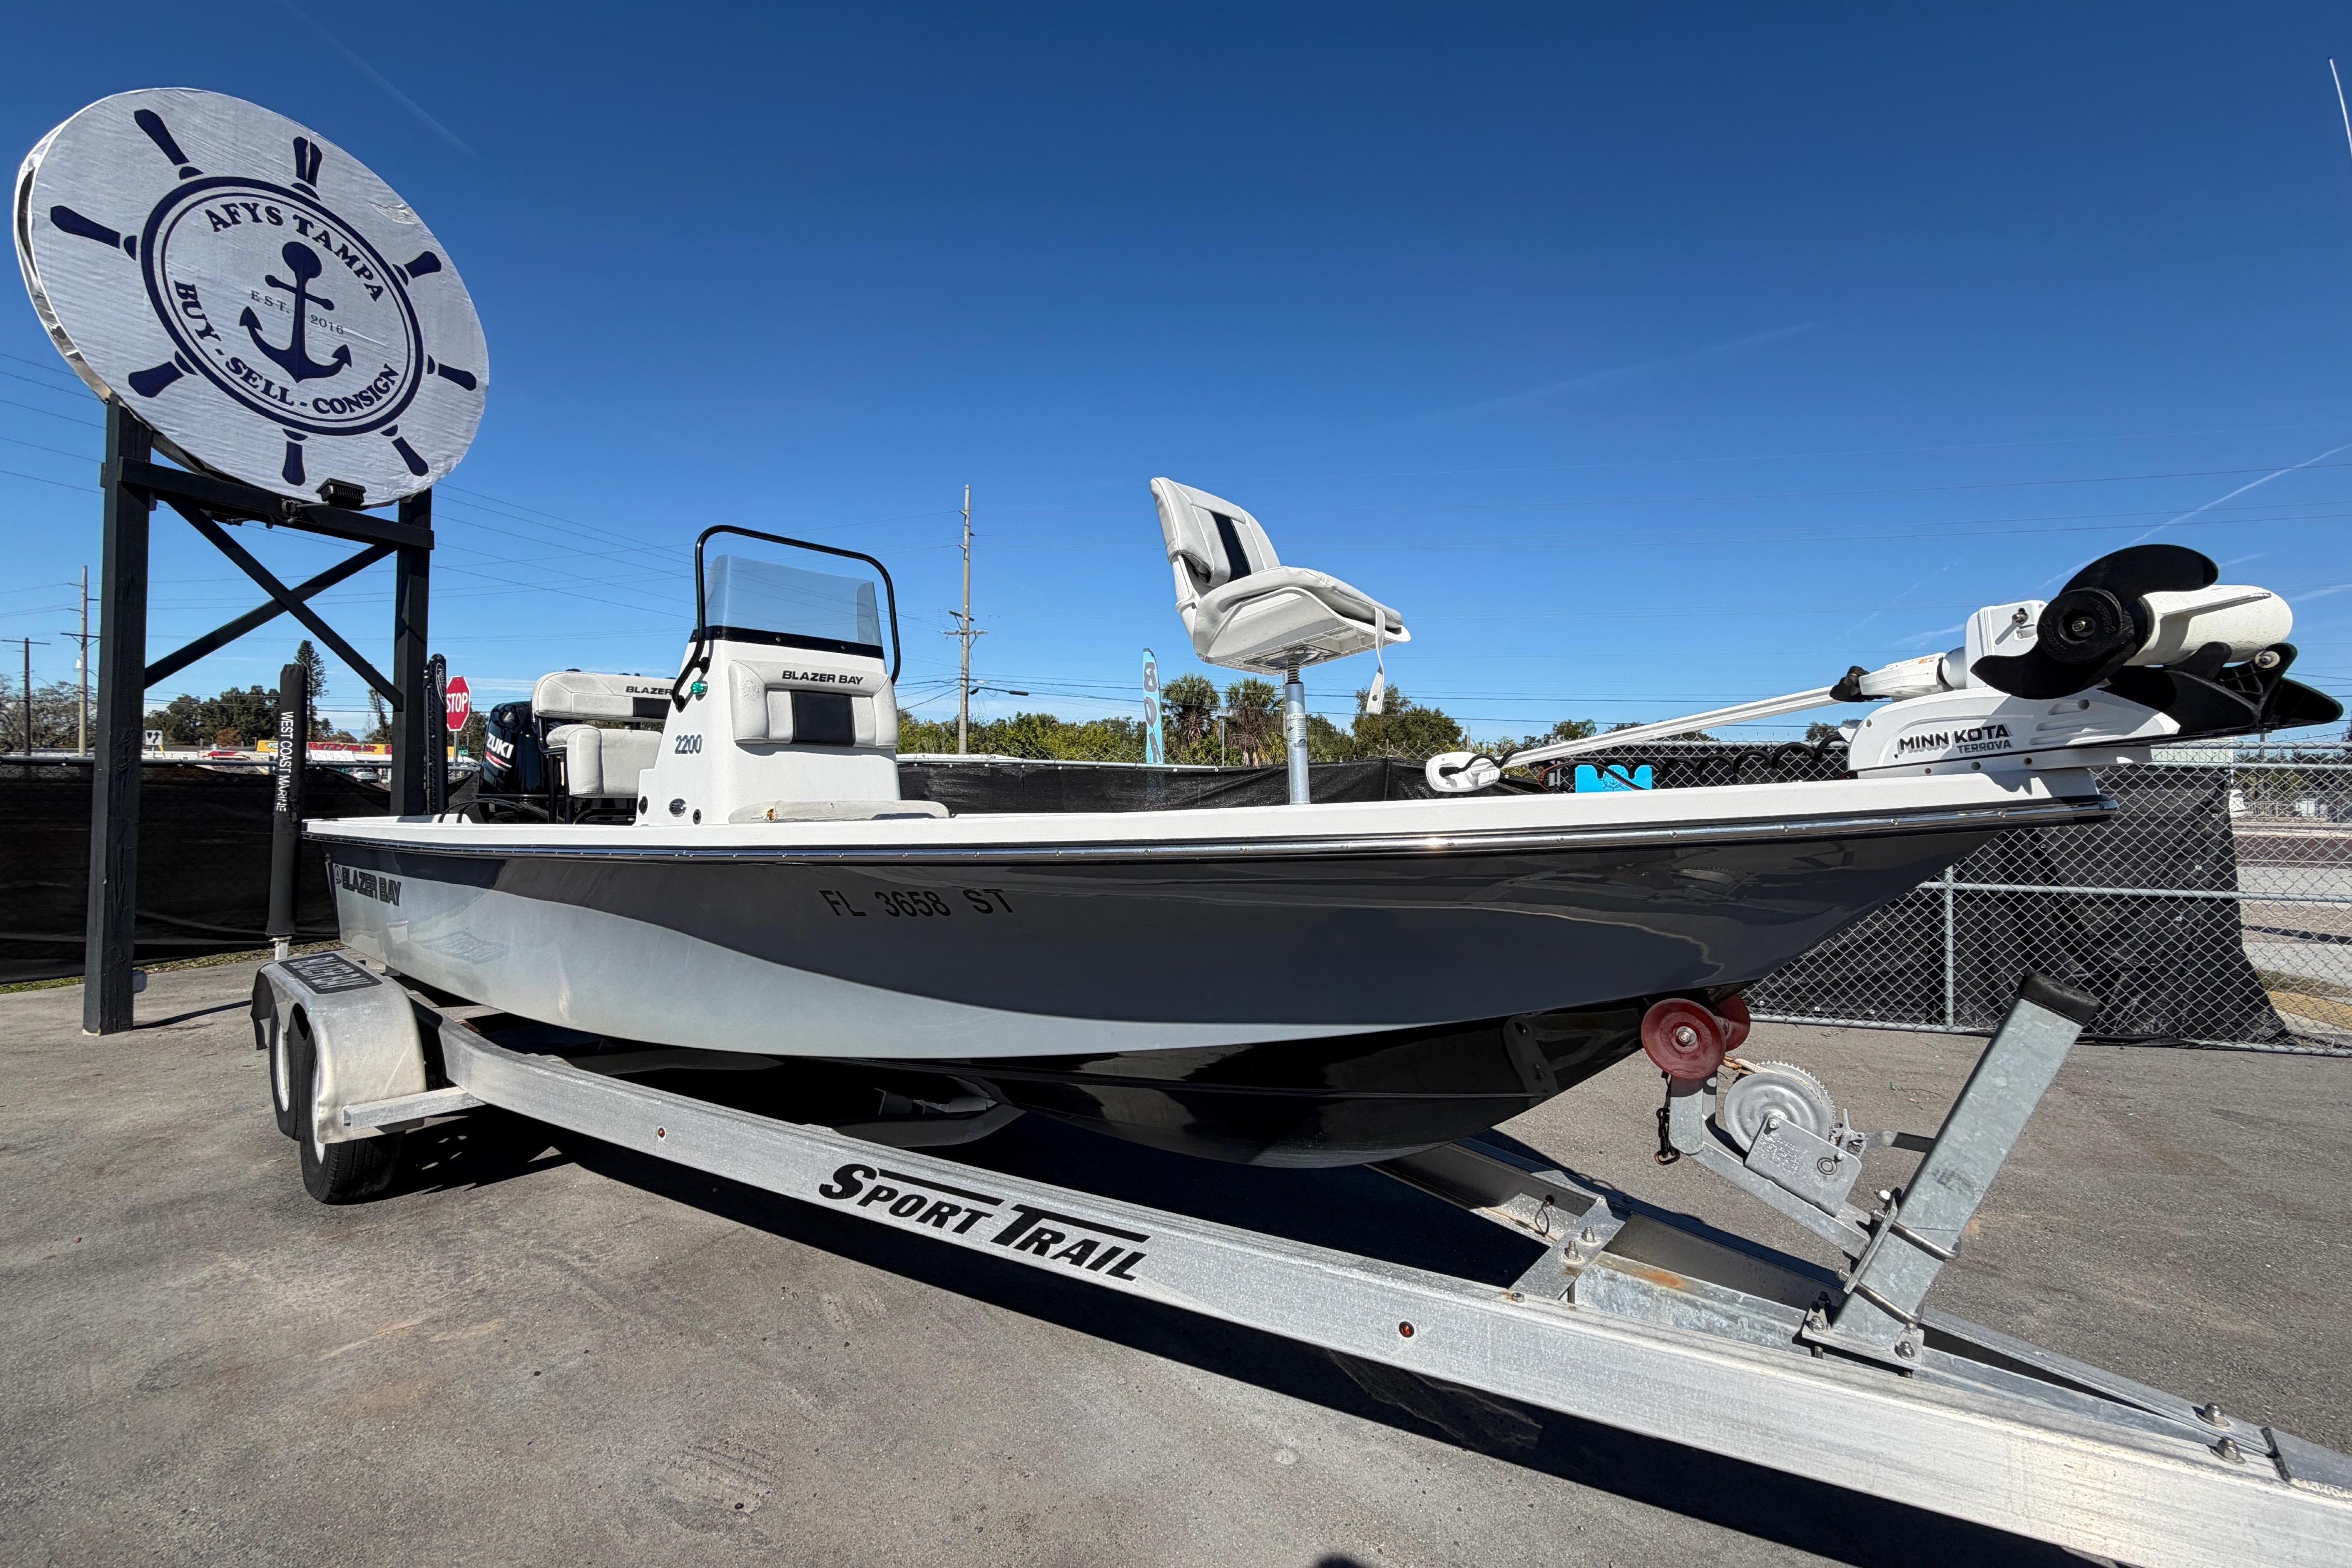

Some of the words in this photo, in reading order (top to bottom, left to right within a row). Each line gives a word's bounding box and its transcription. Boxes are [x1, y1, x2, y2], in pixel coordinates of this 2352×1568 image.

[205, 202, 283, 232] AFYS
[293, 214, 383, 302] TAMPA
[250, 290, 290, 313] EST.
[310, 314, 344, 335] 2016
[174, 280, 222, 342] BUY
[225, 357, 294, 406] SELL
[312, 363, 399, 414] CONSIGN
[625, 686, 673, 696] BLAZER
[782, 670, 836, 683] BLAZER
[838, 674, 864, 685] BAY
[446, 692, 468, 713] STOP
[280, 712, 294, 739] WEST
[1899, 732, 1950, 751] MINN
[1954, 723, 2010, 744] KOTA
[279, 741, 293, 773] COAST
[674, 734, 703, 755] 2200
[1956, 739, 2012, 754] TERROVA
[276, 775, 291, 812] MARINE
[342, 867, 378, 900] BLAZER
[379, 877, 402, 907] BAY
[819, 889, 867, 916] FL
[874, 891, 951, 917] 3658
[962, 888, 1014, 914] ST
[819, 1163, 996, 1235] SPORT
[990, 1203, 1151, 1282] TRAIL
